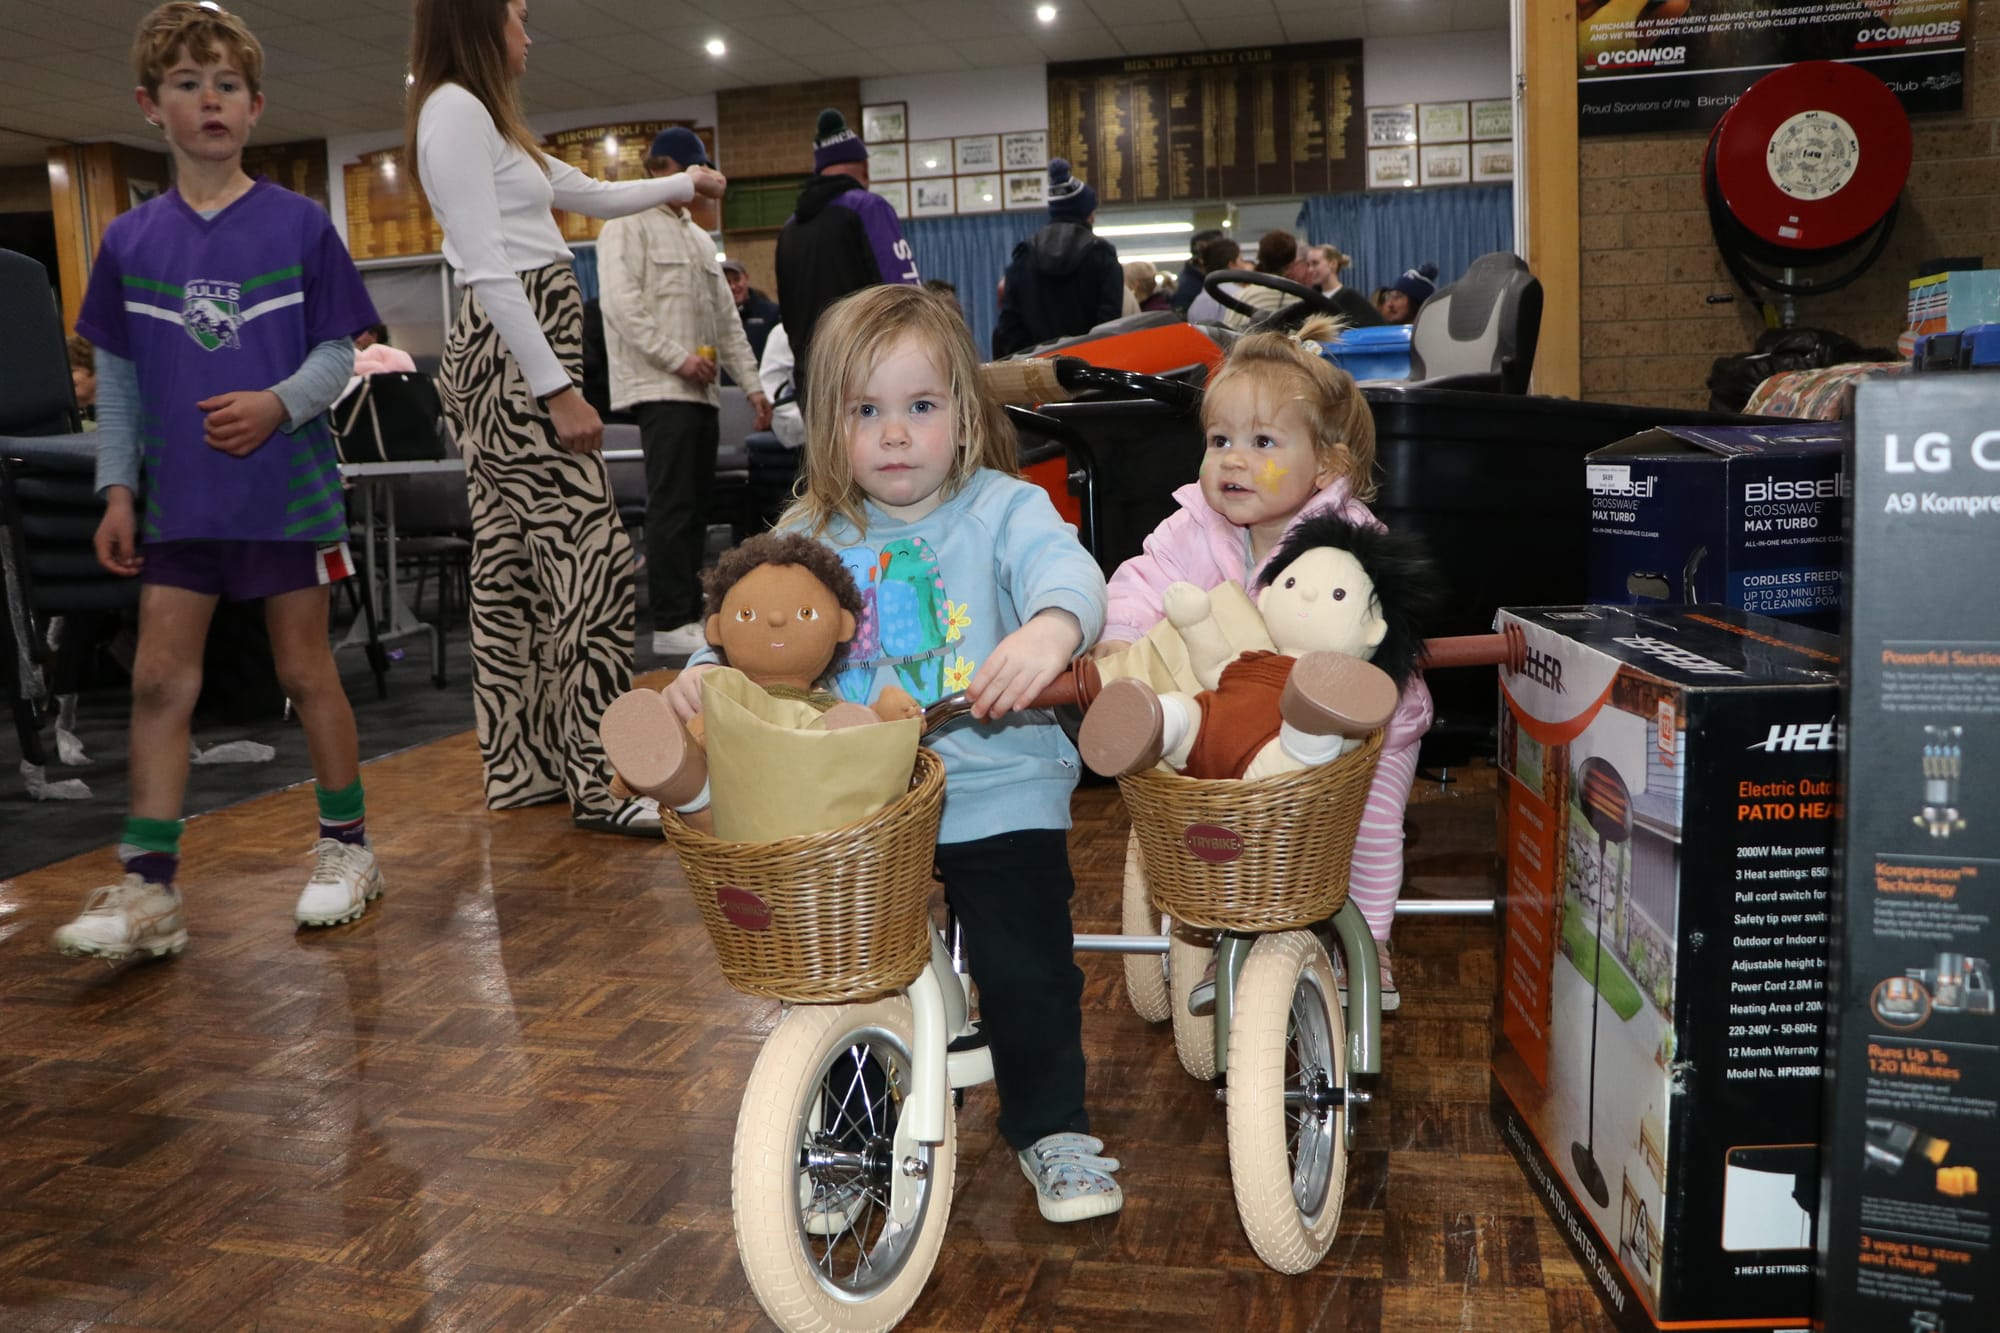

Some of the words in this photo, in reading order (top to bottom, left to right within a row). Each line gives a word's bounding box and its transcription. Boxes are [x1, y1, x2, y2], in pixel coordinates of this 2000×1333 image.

[1590, 21, 1635, 31] PURCHASE
[1637, 19, 1654, 29] ANY
[1656, 15, 1708, 28] MACHINERY,
[1710, 12, 1755, 22] GUIDANCE
[1756, 11, 1769, 19] OR
[1771, 6, 1823, 17] PASSENGER
[1825, 2, 1862, 12] VEHICLE
[1864, 0, 1893, 8] FROM
[1590, 32, 1608, 41] AND
[1610, 31, 1623, 40] WE
[1625, 30, 1644, 39] WILL
[1646, 27, 1680, 38] DONATE
[1681, 25, 1706, 35] CASH
[1707, 23, 1731, 33] BACK
[1733, 22, 1745, 30] TO
[1747, 20, 1771, 29] YOUR
[1773, 17, 1798, 27] CLUB
[1800, 16, 1808, 24] IN
[1809, 11, 1871, 24] RECOGNITION
[1873, 10, 1885, 18] OF
[1887, 6, 1914, 16] YOUR
[1915, 1, 1960, 14] SUPPORT.
[1857, 20, 1961, 42] O'CONNORS
[1182, 53, 1234, 66] CRICKET
[1239, 50, 1272, 62] CLUB
[1597, 46, 1686, 65] O'CONNOR
[1582, 104, 1611, 115] Proud
[1614, 101, 1660, 114] Sponsors
[1662, 99, 1673, 109] of
[1674, 98, 1690, 109] the
[557, 127, 606, 145] BIRCHIP
[609, 124, 641, 137] GOLF
[185, 285, 240, 300] BULLS
[1884, 432, 1951, 473] LG
[1592, 498, 1639, 511] CROSSWAVE
[1745, 501, 1822, 517] CROSSWAVE
[1884, 493, 1917, 513] A9
[1592, 510, 1608, 521] MAX
[1609, 511, 1636, 522] TURBO
[1744, 519, 1772, 532] MAX
[1775, 517, 1818, 531] TURBO
[1745, 539, 1780, 548] ALL-IN-ONE
[1781, 536, 1826, 546] MULTI-SURFACE
[1743, 572, 1802, 588] CORDLESS
[1744, 591, 1757, 602] UP
[1759, 590, 1773, 601] TO
[1775, 588, 1788, 600] 30
[1790, 585, 1834, 598] MINUTES
[1744, 602, 1759, 613] OF
[1760, 598, 1813, 611] CLEANING
[1815, 596, 1841, 608] POW
[1881, 649, 1949, 666] Powerful
[1739, 781, 1795, 798] Electric
[1737, 803, 1795, 821] PATIO
[1191, 836, 1238, 850] TRYBIKE
[1737, 846, 1768, 857] 2000W
[1771, 845, 1792, 856] Max
[1795, 846, 1826, 858] power
[1736, 870, 1742, 880] 3
[1744, 868, 1767, 880] Heat
[1768, 867, 1808, 880] settings:
[1736, 892, 1753, 902] Pull
[1755, 891, 1777, 901] cord
[1779, 890, 1811, 901] switch
[1813, 890, 1827, 900] for
[1874, 877, 1957, 899] Technology
[1734, 914, 1764, 926] Safety
[1767, 914, 1779, 926] tip
[1781, 914, 1802, 924] over
[1733, 936, 1770, 947] Outdoor
[1773, 937, 1784, 946] or
[1786, 935, 1816, 946] Indoor
[1732, 959, 1782, 972] Adjustable
[1785, 958, 1814, 971] height
[1731, 982, 1761, 993] Power
[1764, 981, 1786, 991] Cord
[1789, 980, 1812, 991] 2.8M
[1814, 979, 1823, 989] in
[1730, 1003, 1766, 1015] Heating
[1768, 1002, 1792, 1013] Area
[1794, 1001, 1804, 1012] of
[1728, 1025, 1771, 1036] 220-240V
[1781, 1023, 1818, 1034] 50-60Hz
[1728, 1047, 1738, 1057] 12
[1740, 1046, 1771, 1057] Month
[1773, 1045, 1819, 1057] Warranty
[1868, 1043, 1904, 1060] Runs
[1906, 1047, 1929, 1063] Up
[1930, 1048, 1949, 1064] To
[1727, 1068, 1757, 1079] Model
[1759, 1067, 1775, 1078] No.
[1869, 1058, 1898, 1072] 120
[1900, 1061, 1961, 1080] Minutes
[1508, 1116, 1526, 1156] Electric
[1526, 1144, 1546, 1189] Outdoor
[1546, 1178, 1567, 1221] PATIO
[1567, 1211, 1597, 1269] HEATER
[1597, 1261, 1626, 1313] 2000W
[1860, 1235, 1870, 1249] 3
[1873, 1240, 1910, 1256] ways
[1911, 1244, 1930, 1258] to
[1931, 1248, 1971, 1263] store
[1734, 1267, 1740, 1275] 3
[1742, 1265, 1764, 1275] HEAT
[1766, 1264, 1809, 1274] SETTINGS:
[1858, 1252, 1886, 1265] and
[1888, 1255, 1938, 1274] charge
